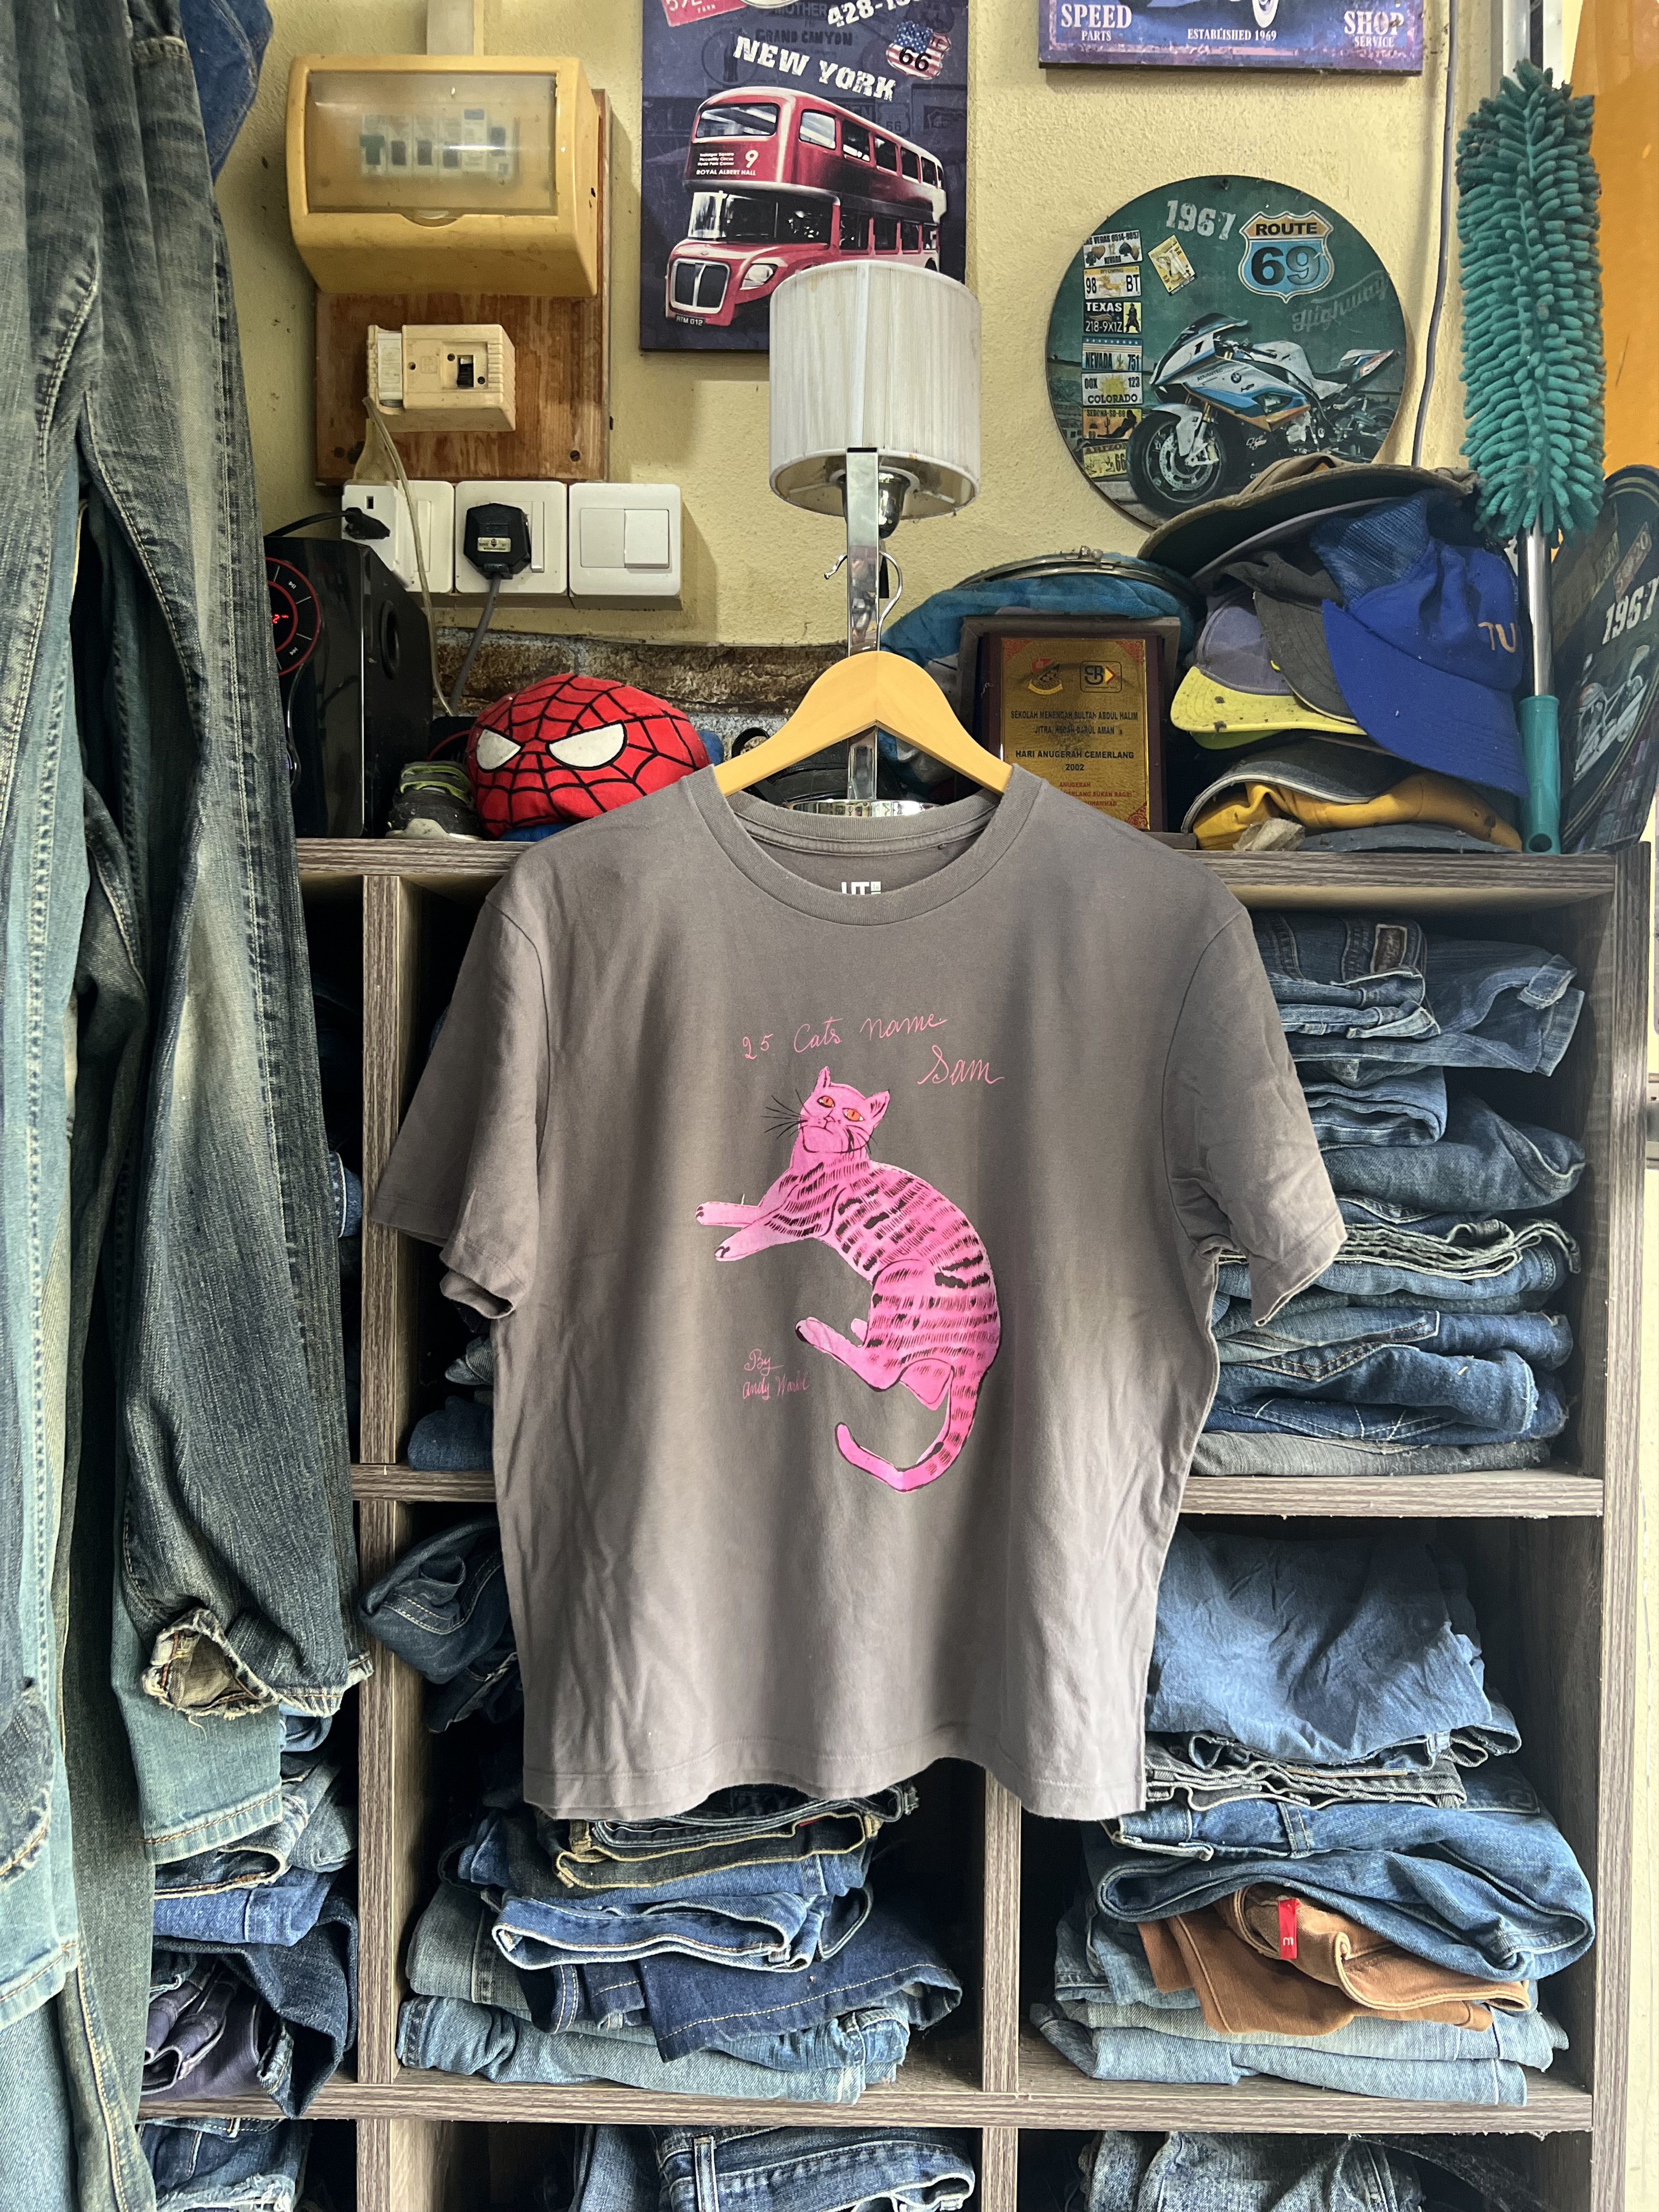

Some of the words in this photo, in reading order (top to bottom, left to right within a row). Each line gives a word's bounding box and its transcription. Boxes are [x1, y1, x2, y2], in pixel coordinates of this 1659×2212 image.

[1061, 4, 1132, 28] SPEED
[1344, 10, 1404, 36] SHOP
[1081, 30, 1112, 42] PARTS
[1187, 28, 1252, 41] ESTABLISHED
[1254, 29, 1277, 42] 1969
[1354, 36, 1395, 48] SERVICE
[733, 36, 810, 77] NEW
[819, 60, 896, 101] YORK
[899, 47, 932, 72] 66
[745, 150, 758, 168] 9
[1166, 200, 1236, 241] 1967
[1256, 222, 1317, 236] ROUTE
[1251, 246, 1321, 286] 69
[1086, 277, 1097, 294] 98
[1126, 275, 1139, 292] BT
[1086, 302, 1122, 312] TEXAS
[690, 318, 703, 327] 012
[1194, 341, 1205, 355] 1
[1085, 352, 1112, 370] NEVADA
[1088, 394, 1138, 404] COLORADO
[1115, 453, 1126, 471] 66
[1602, 576, 1659, 645] 1967
[1011, 711, 1038, 719] SEKOLAH
[1119, 711, 1138, 720] HALIM
[1097, 726, 1115, 735] AMAN
[1016, 750, 1035, 758] HARI
[1085, 751, 1134, 759] CEMERLANG
[794, 1017, 844, 1053] Cats
[917, 1045, 1005, 1085] Sam
[744, 1348, 784, 1376] By
